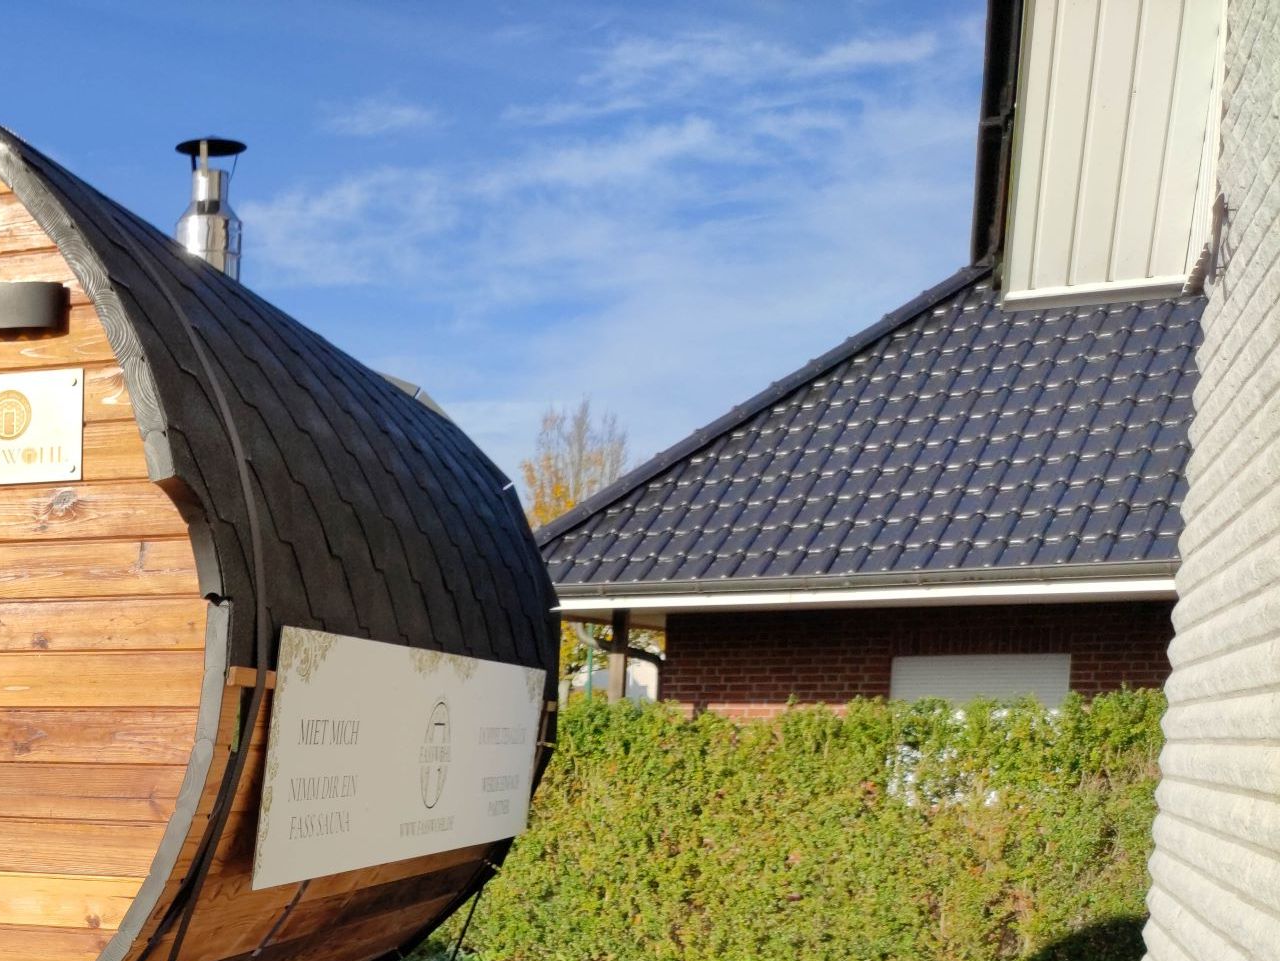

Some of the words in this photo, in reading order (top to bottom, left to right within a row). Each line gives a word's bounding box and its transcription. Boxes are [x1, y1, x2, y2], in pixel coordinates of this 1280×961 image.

[298, 719, 329, 745] MIET
[329, 719, 361, 745] MICH
[288, 777, 321, 803] NIMM
[317, 775, 340, 800] DIR
[338, 774, 359, 798] EIN
